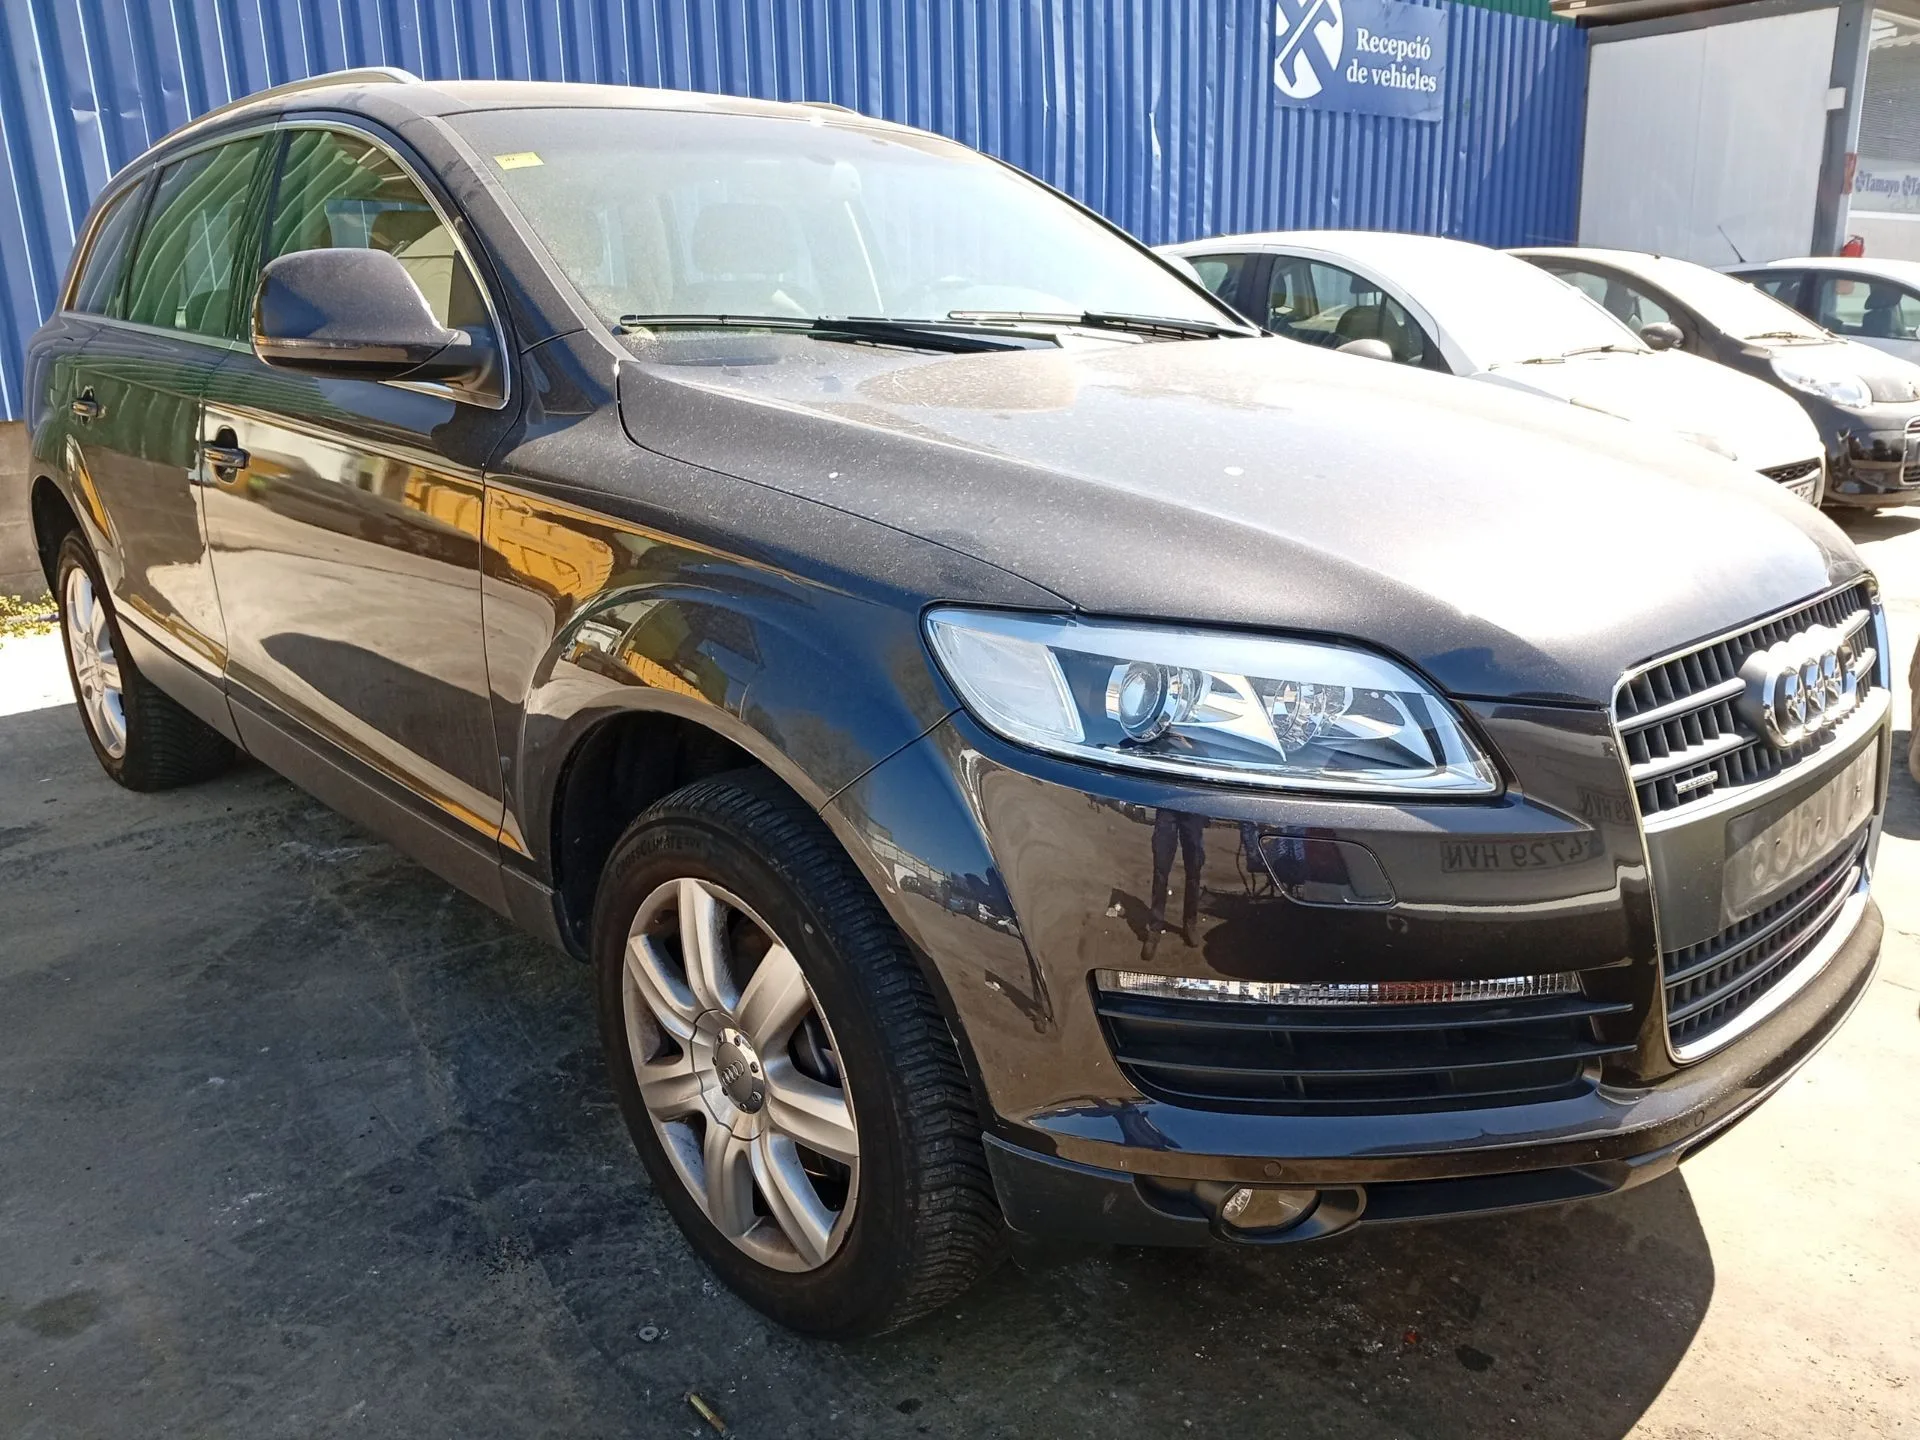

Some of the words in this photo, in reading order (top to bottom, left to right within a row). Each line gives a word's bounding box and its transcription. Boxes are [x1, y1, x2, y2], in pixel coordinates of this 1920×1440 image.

[1356, 27, 1431, 62] Recepció
[1346, 58, 1368, 84] de
[1371, 63, 1437, 92] vehicles
[1865, 173, 1900, 199] Tamayo
